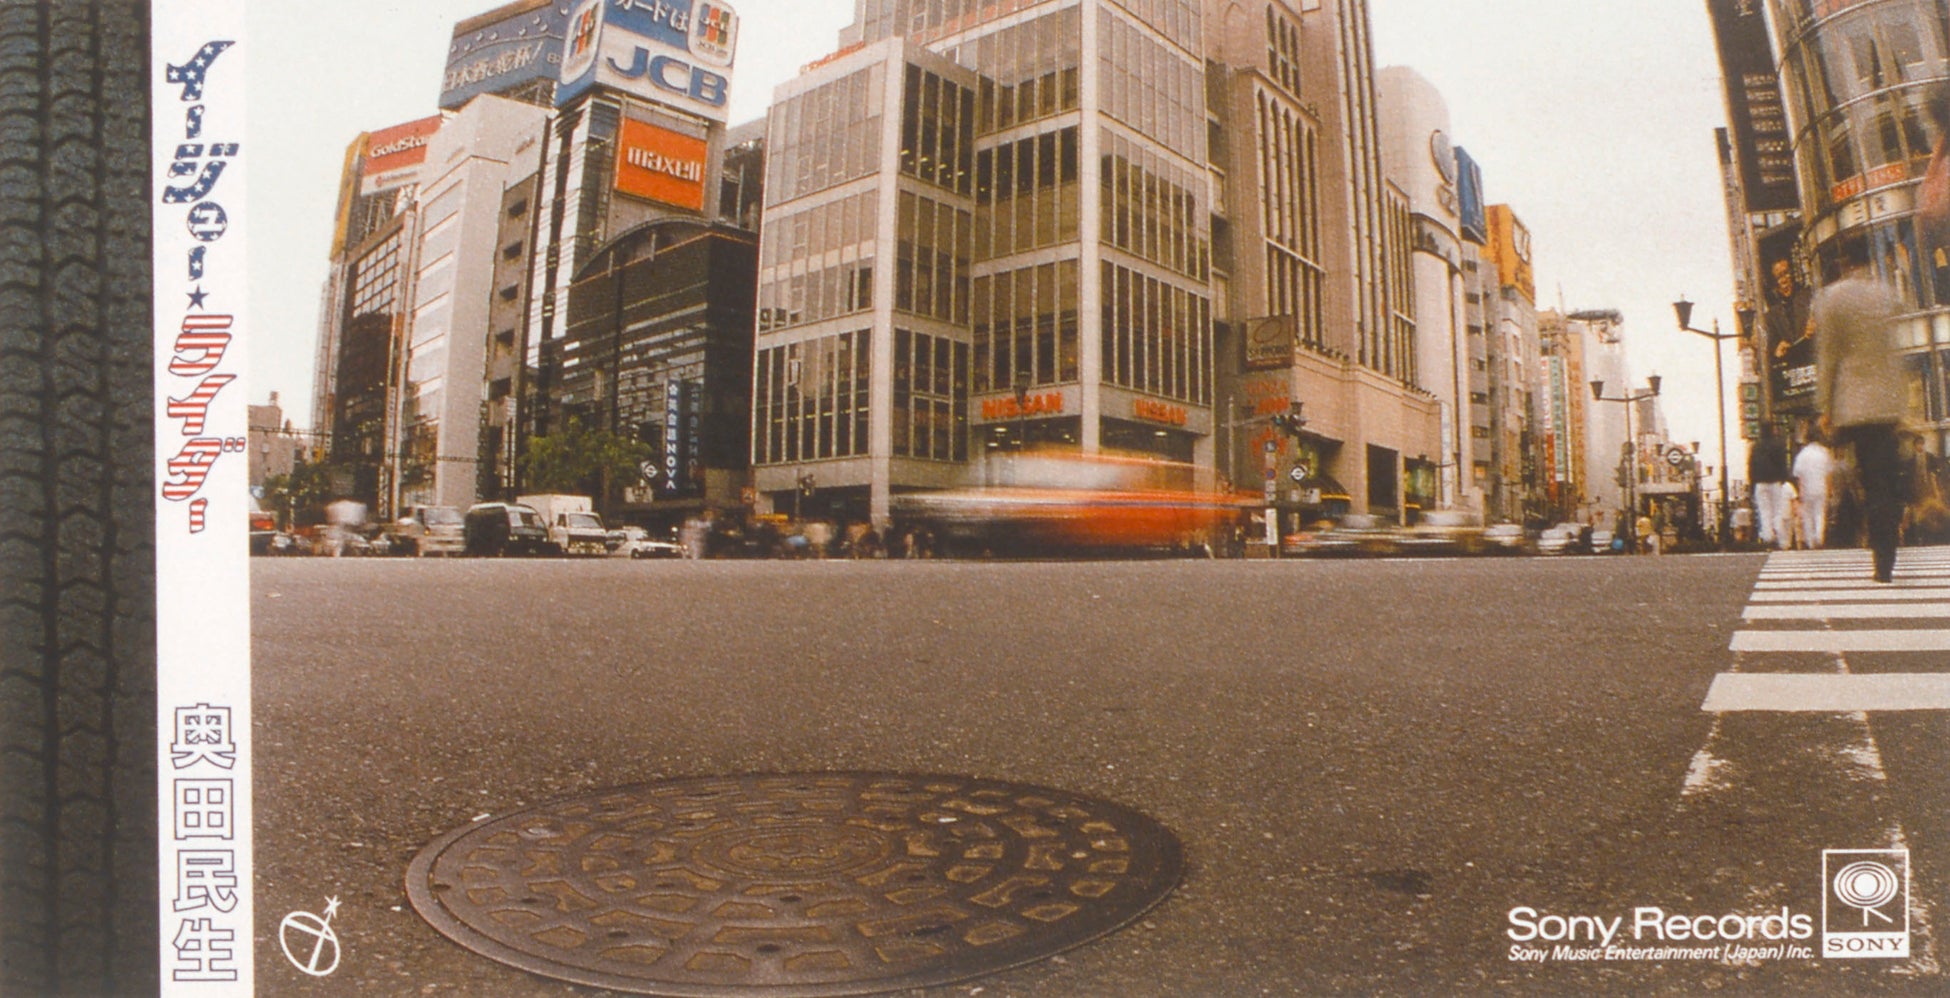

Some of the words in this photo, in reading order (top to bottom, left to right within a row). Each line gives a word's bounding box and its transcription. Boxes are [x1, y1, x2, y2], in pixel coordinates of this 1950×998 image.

[606, 46, 728, 107] JCB
[370, 134, 428, 159] GoldSta
[627, 146, 702, 182] maxell
[983, 392, 1064, 420] NISSAN
[1134, 399, 1188, 426] NISSAN
